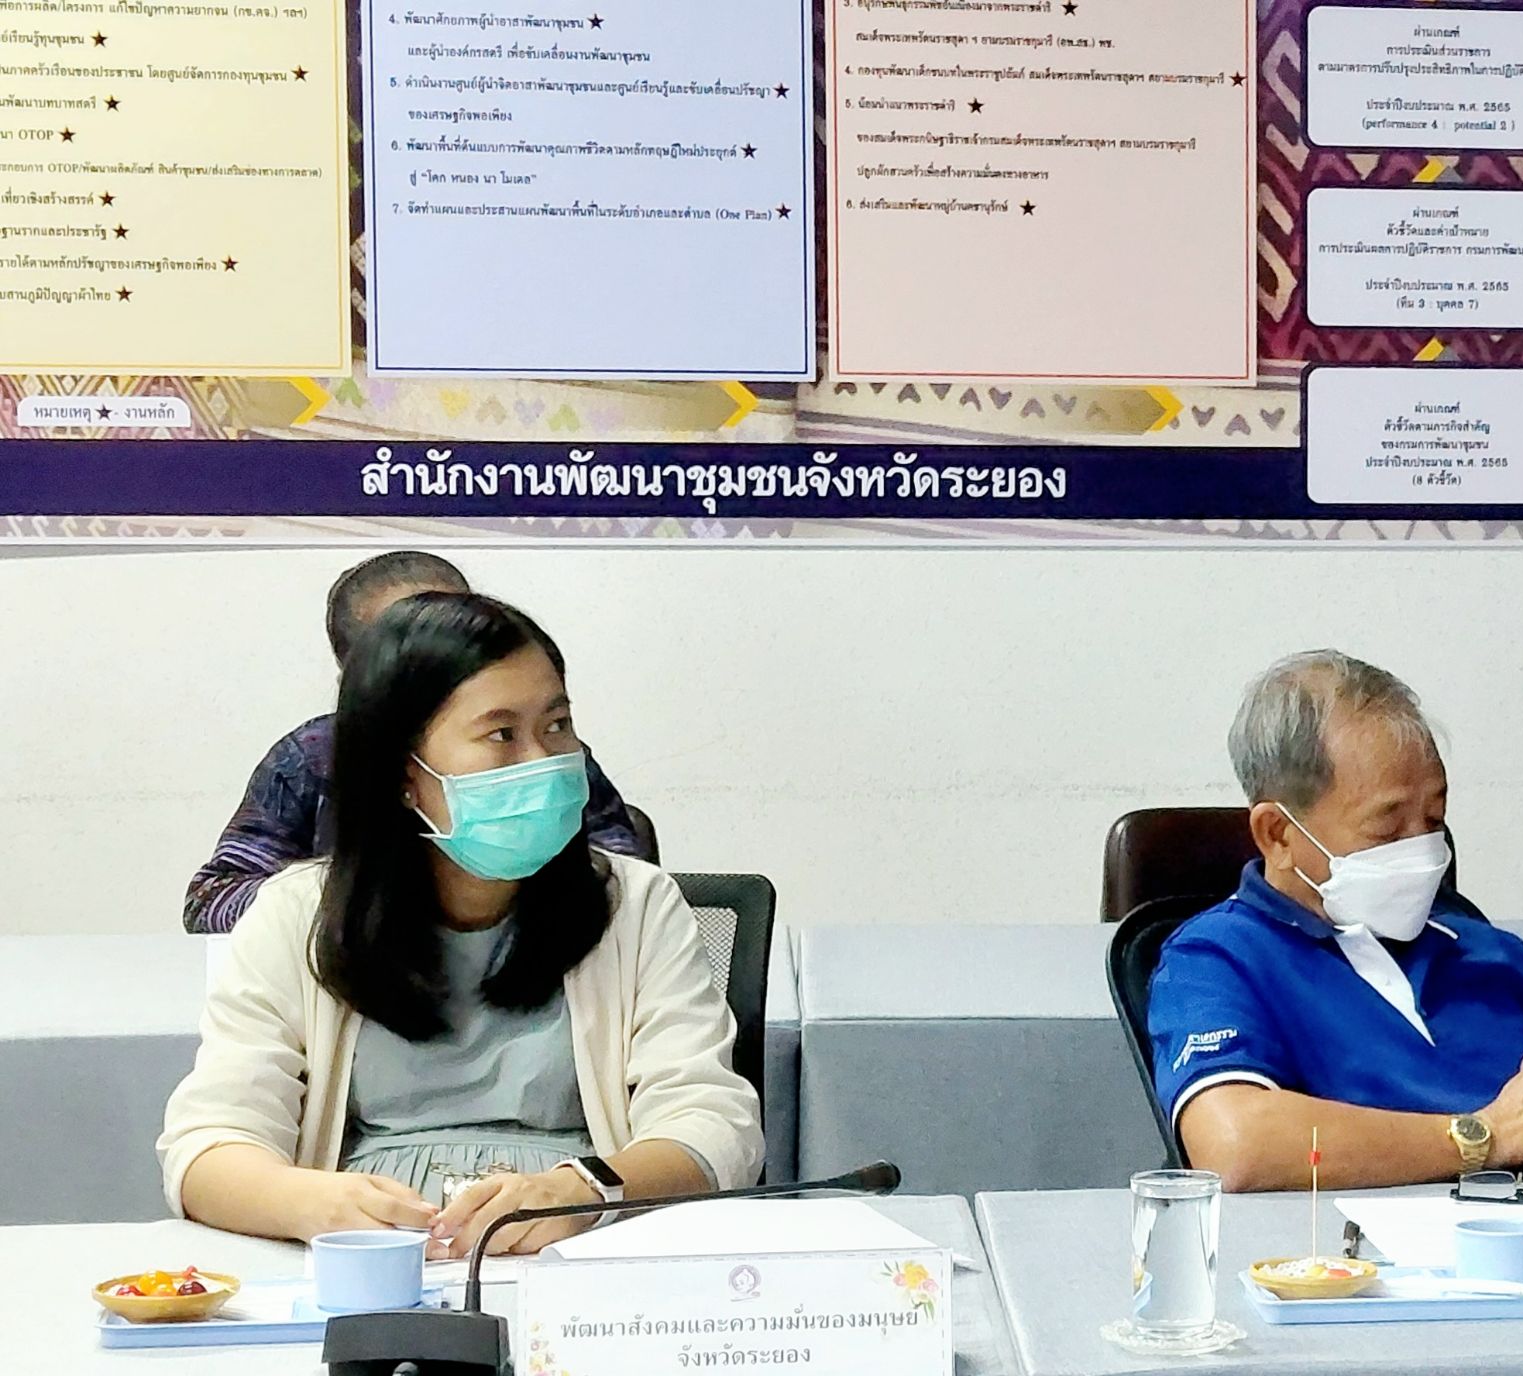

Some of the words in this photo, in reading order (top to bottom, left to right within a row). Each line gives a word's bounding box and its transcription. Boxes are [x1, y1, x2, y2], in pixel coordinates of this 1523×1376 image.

[0, 62, 143, 78] นภาคครัวเรือนของประชาชน
[1484, 102, 1511, 112] 2565
[1431, 120, 1438, 129] 4
[1454, 121, 1496, 132] potential
[18, 129, 54, 140] OTOP
[1482, 281, 1509, 291] 2565
[1419, 299, 1425, 308] 3
[34, 407, 91, 423] หมายเหตุ
[124, 403, 174, 418] งานหลัก
[1482, 458, 1508, 467] 2565
[360, 448, 1067, 514] สำนักงานพัฒนาชุมชนจังหวัดระยอง
[678, 1345, 812, 1369] จังหวัดระยอง
